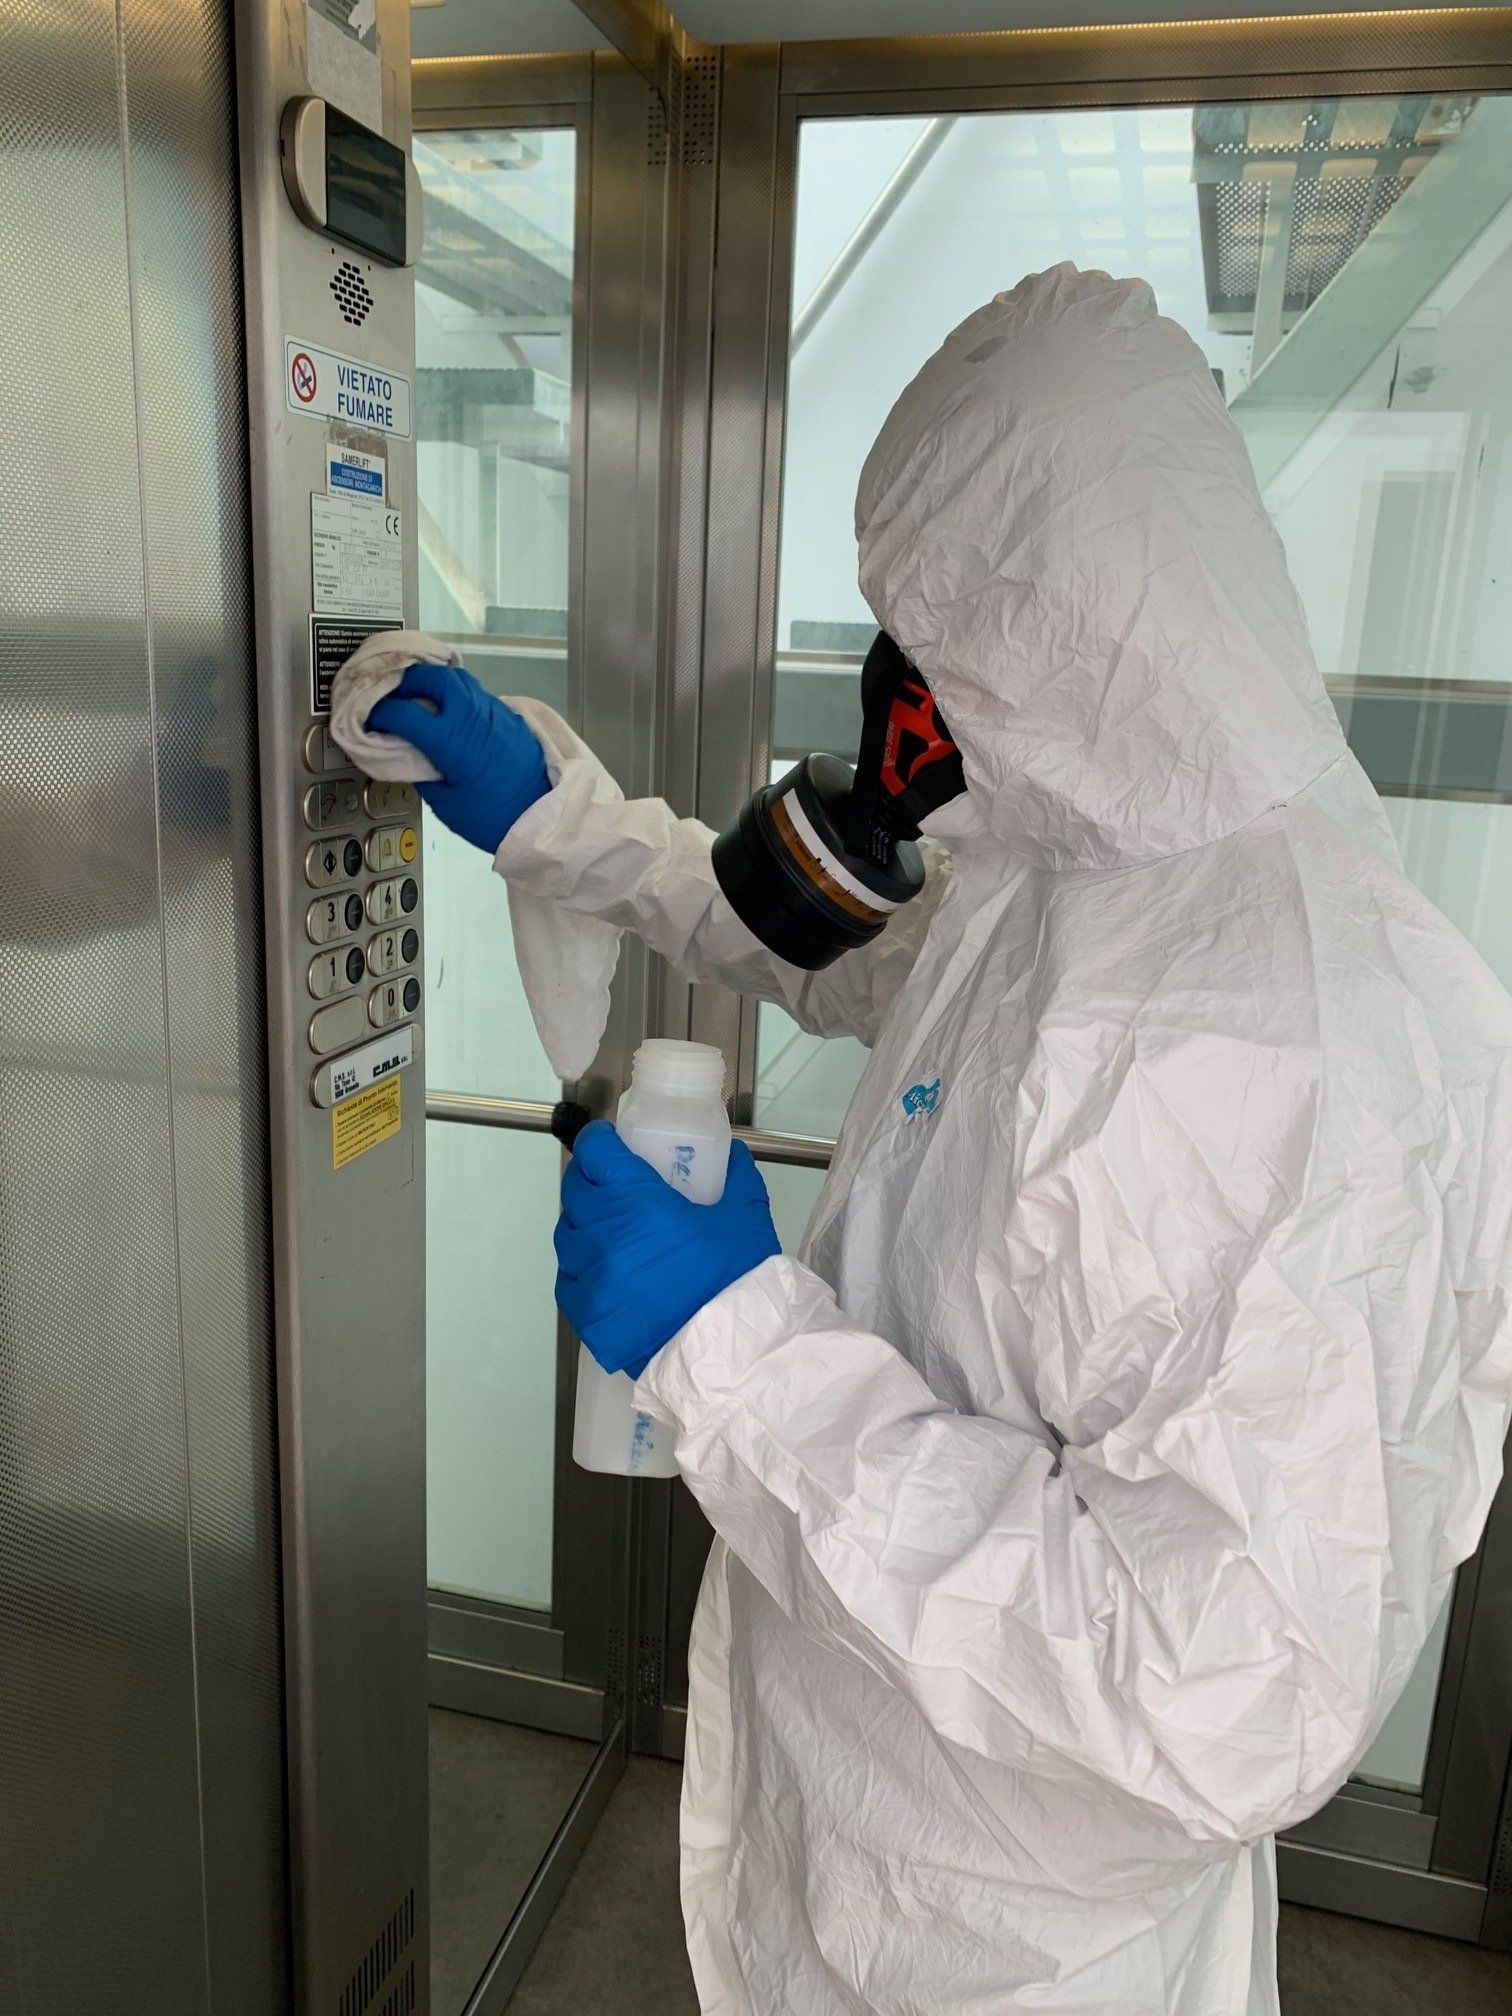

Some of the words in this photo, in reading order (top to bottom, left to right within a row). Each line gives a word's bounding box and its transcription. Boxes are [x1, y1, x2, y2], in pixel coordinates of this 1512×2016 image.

[337, 365, 392, 401] VIETATO
[338, 392, 393, 427] FUMARE
[385, 514, 399, 536] CE
[385, 885, 391, 905] 4
[328, 902, 335, 922] 3
[386, 937, 393, 957] 2
[330, 957, 335, 977] 1
[388, 988, 394, 1007] 0
[363, 1091, 377, 1103] Pronto
